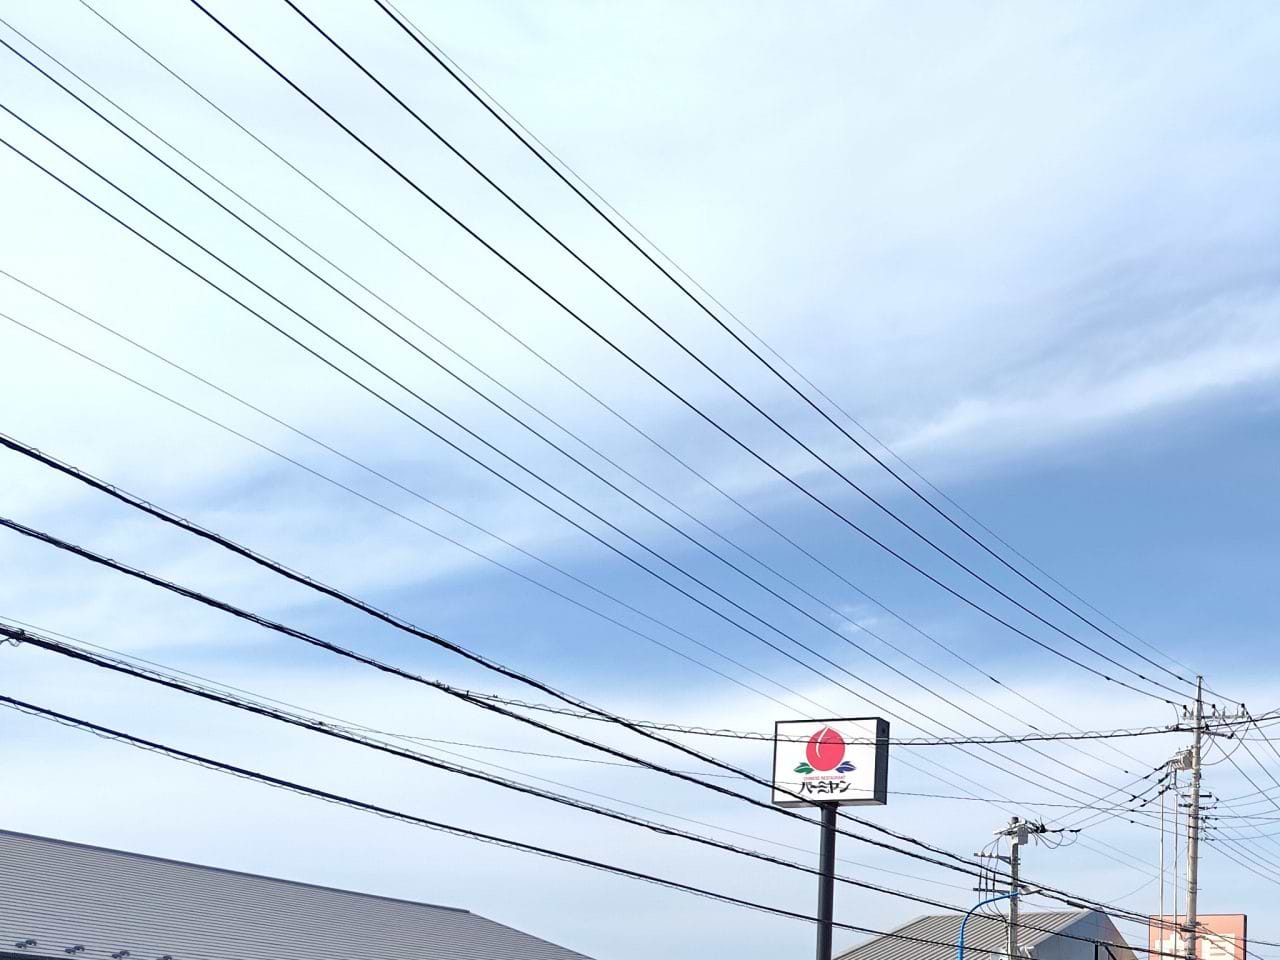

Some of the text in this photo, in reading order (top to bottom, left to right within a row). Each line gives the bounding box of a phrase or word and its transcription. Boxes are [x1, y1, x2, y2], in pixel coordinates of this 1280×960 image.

[798, 781, 851, 794] バーミヤン
